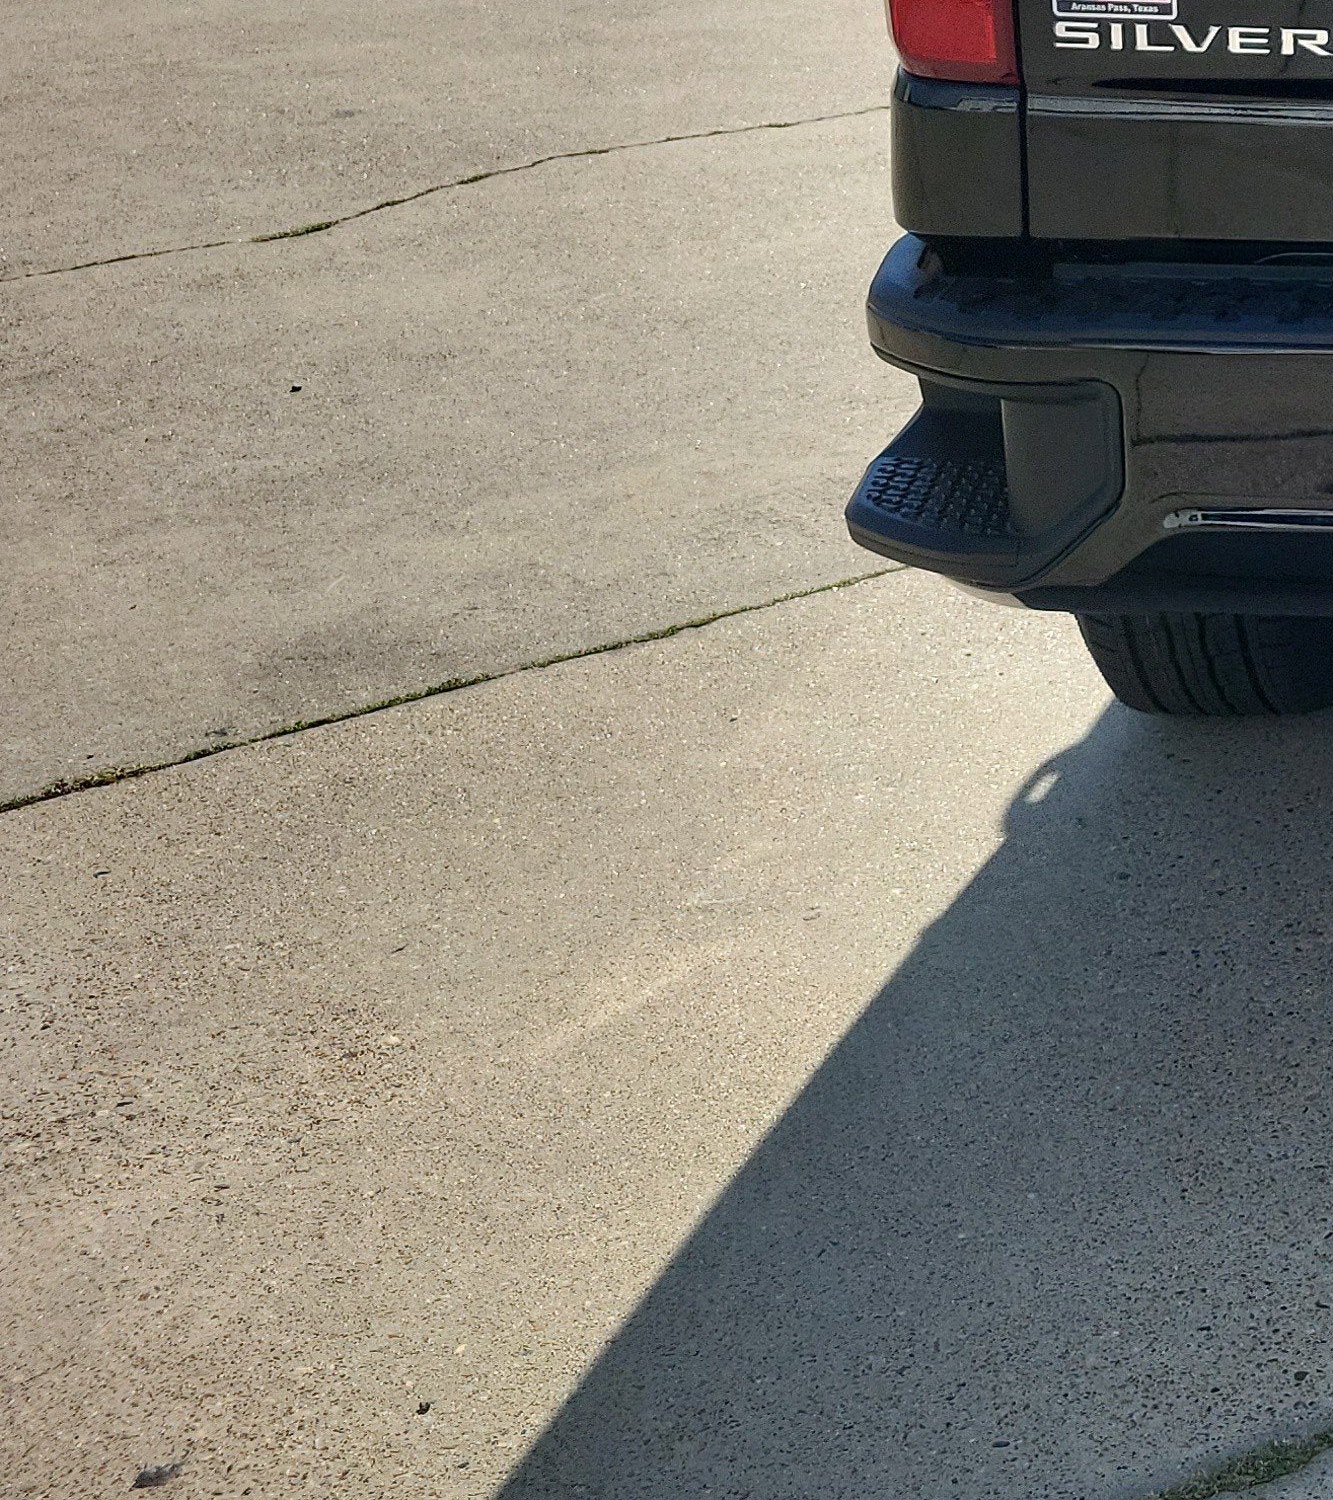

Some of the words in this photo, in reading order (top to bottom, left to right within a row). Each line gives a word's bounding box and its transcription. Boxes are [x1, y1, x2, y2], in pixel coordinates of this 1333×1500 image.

[1071, 2, 1106, 11] Aransas
[1107, 3, 1131, 13] Pass,
[1133, 5, 1159, 13] Texas
